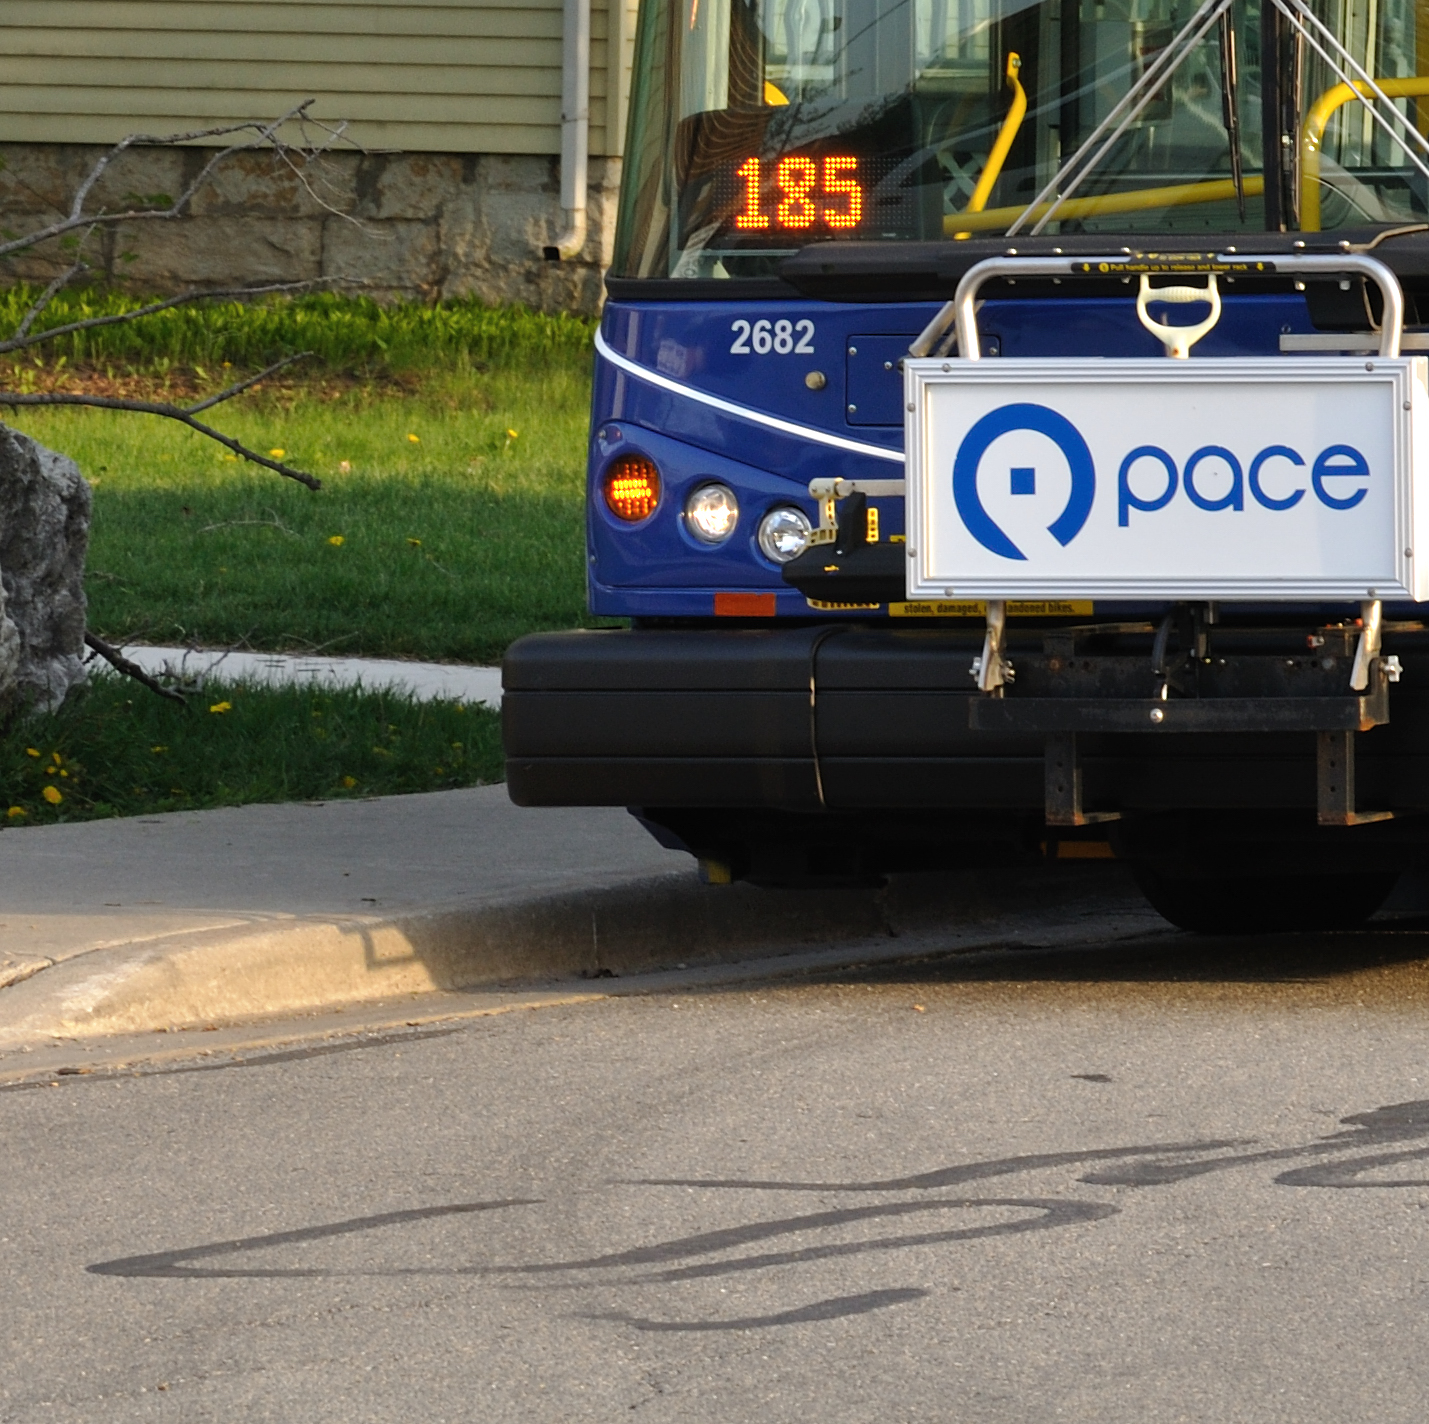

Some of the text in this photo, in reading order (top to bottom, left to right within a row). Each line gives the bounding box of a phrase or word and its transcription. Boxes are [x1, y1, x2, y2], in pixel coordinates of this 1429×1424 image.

[735, 156, 863, 229] 185
[730, 319, 816, 355] 2682
[1118, 443, 1371, 527] pace
[904, 602, 1076, 615] stolen, damaged, andoned bikes.
